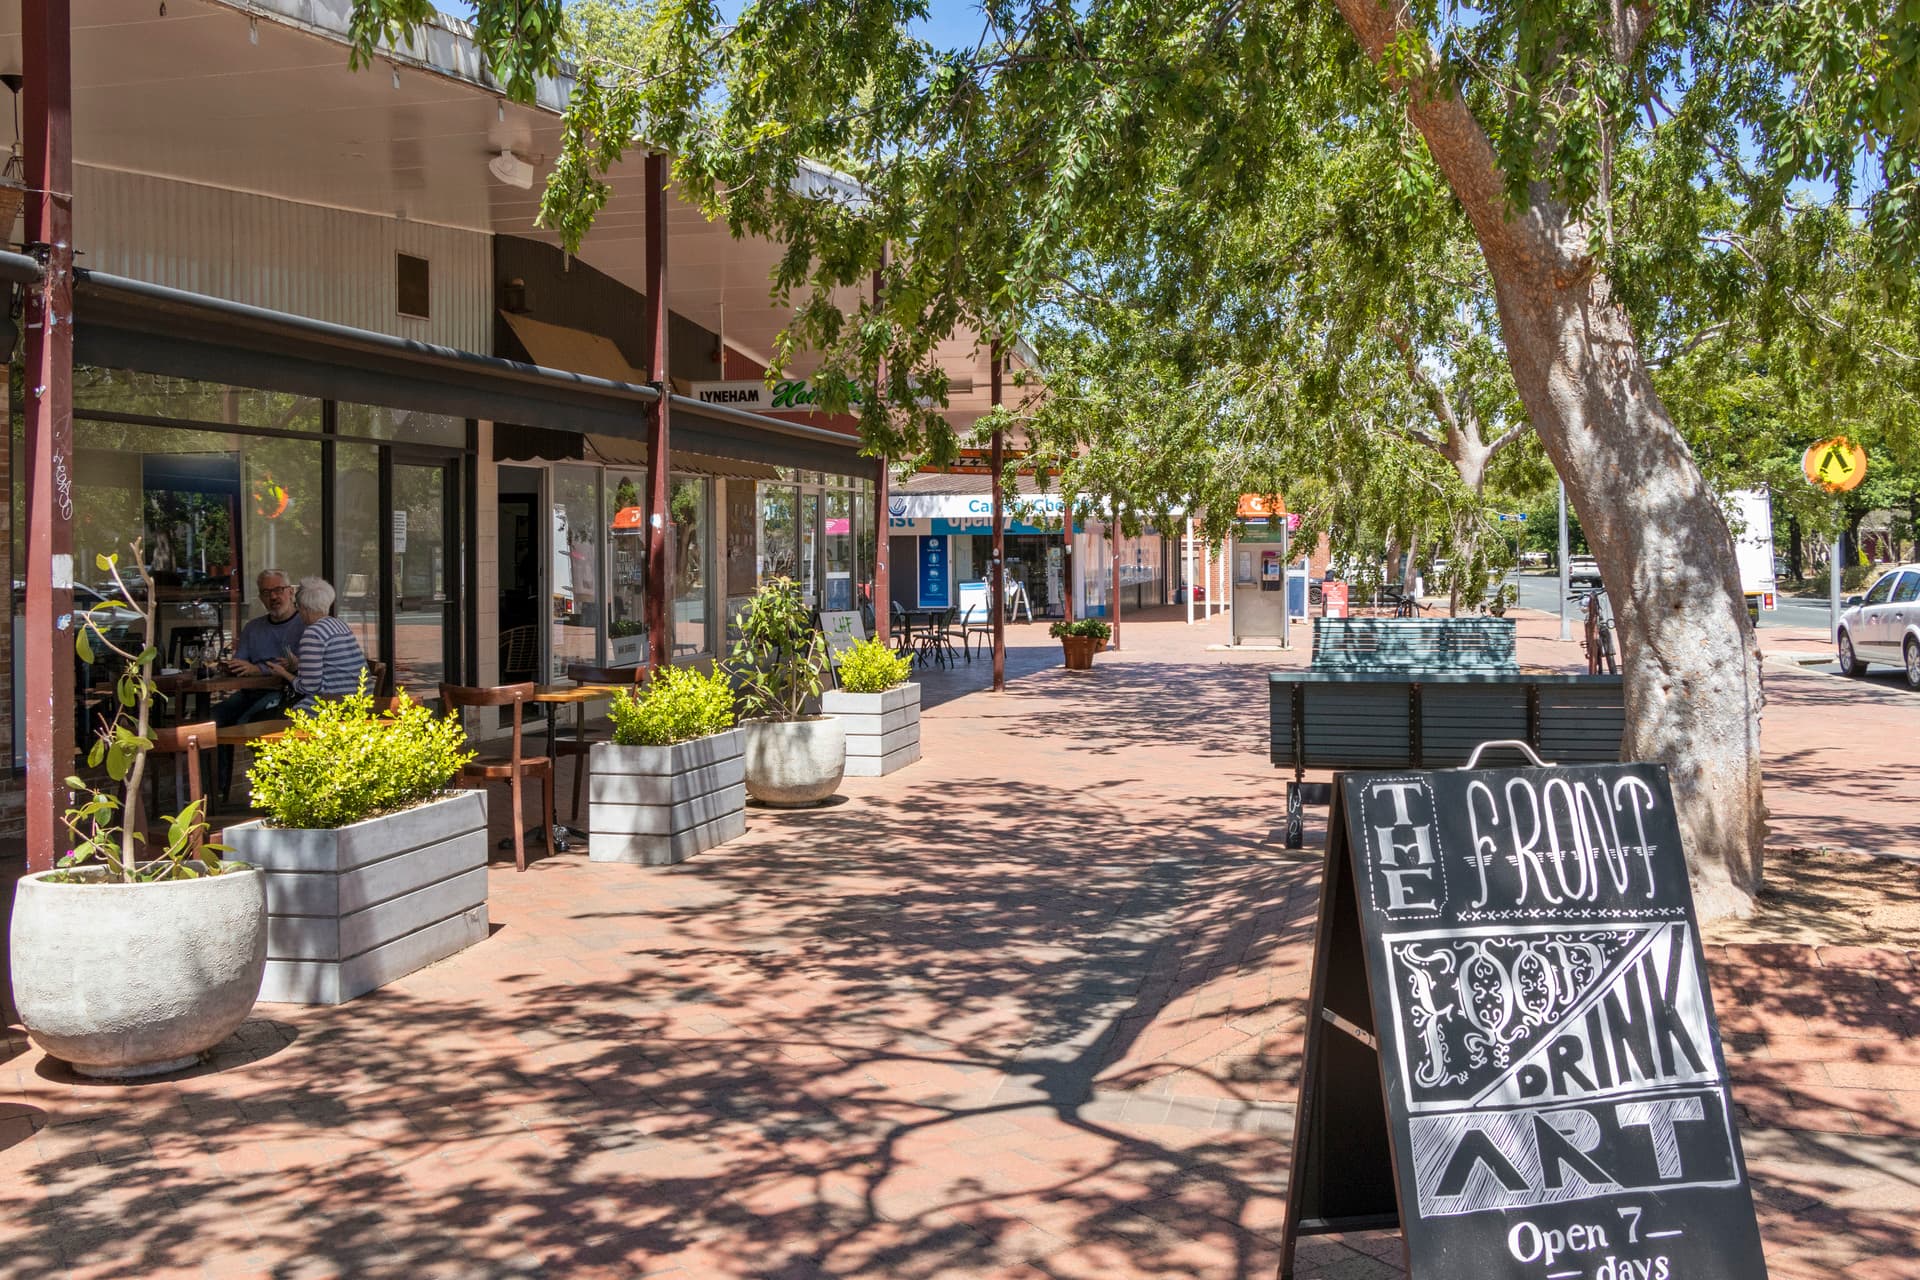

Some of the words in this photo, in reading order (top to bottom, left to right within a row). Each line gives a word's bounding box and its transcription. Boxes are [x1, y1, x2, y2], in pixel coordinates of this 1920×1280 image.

[700, 389, 759, 403] LYNEHAM
[1372, 783, 1437, 910] THE
[1464, 776, 1658, 908] FRONT
[1393, 932, 1605, 1088] FOOD
[1515, 923, 1709, 1099] DRINK
[1416, 1096, 1705, 1205] ART
[1507, 1221, 1609, 1265] Open
[1617, 1206, 1642, 1243] 7
[1596, 1254, 1669, 1280] days
